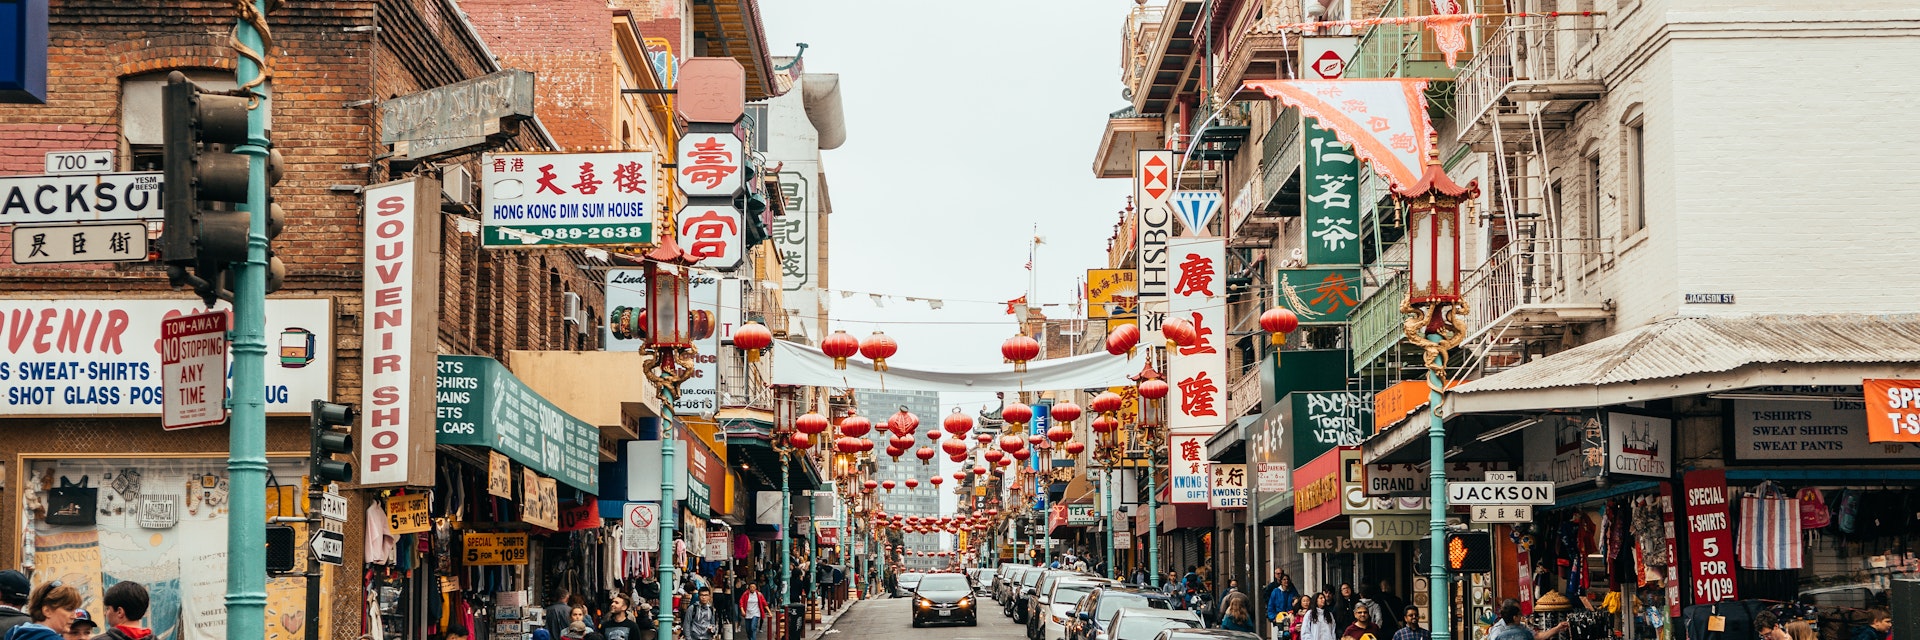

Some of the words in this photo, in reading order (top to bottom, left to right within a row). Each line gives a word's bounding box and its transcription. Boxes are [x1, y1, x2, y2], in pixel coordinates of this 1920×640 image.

[55, 155, 87, 170] 700
[493, 157, 524, 173] 香港
[536, 161, 647, 195] 天喜樓
[1307, 124, 1358, 252] 仁茗茶
[493, 204, 524, 219] HONG
[527, 204, 557, 219] KONG
[560, 203, 579, 218] DIM
[582, 203, 605, 218] SUM
[607, 202, 644, 217] HOUSE
[541, 226, 642, 240] 989-2638
[1143, 208, 1168, 289] HSBC
[372, 195, 404, 374] SOUVENIR
[1687, 294, 1721, 303] JACKSON
[1723, 294, 1733, 303] ST
[0, 307, 129, 355] VENIR
[166, 317, 220, 335] TOW-AWAY
[163, 337, 179, 362] NO
[181, 337, 222, 360] STOPPING
[19, 361, 150, 380] SWEAT-SHIRTS
[180, 364, 205, 384] ANY
[8, 386, 56, 405] SHOT
[64, 386, 120, 405] GLASS
[265, 385, 288, 404] UG
[179, 386, 206, 406] TIME
[1753, 411, 1812, 421] T-SHIRTS
[1888, 413, 1920, 434] T-S
[370, 386, 399, 472] SHOP
[443, 423, 475, 434] CAPS
[1753, 427, 1796, 436] SWEAT
[1800, 426, 1848, 435] SHIRTS
[1753, 441, 1797, 451] SWEAT
[1801, 441, 1843, 450] PANTS
[1258, 463, 1267, 472] NO
[1174, 476, 1202, 488] KWONG
[1226, 467, 1244, 486] 行
[1373, 477, 1414, 491] GRAND
[1490, 473, 1505, 481] 700
[1213, 488, 1241, 496] KWONG
[1453, 486, 1548, 500] JACKSON
[1689, 487, 1724, 507] SPECIAL
[322, 497, 345, 516] GRANT
[1221, 498, 1248, 506] GIFTS
[1069, 507, 1086, 516] TEA
[391, 515, 399, 529] 5
[400, 517, 408, 525] FOR
[1376, 520, 1426, 537] JADE
[1688, 512, 1727, 533] T-SHIRTS
[467, 537, 492, 547] SPECIAL
[496, 537, 524, 547] T-SHIRTS
[1300, 536, 1333, 549] Fine
[1335, 536, 1393, 553] Jewelry
[1703, 537, 1719, 557] 5
[467, 549, 478, 561] 5
[1668, 544, 1674, 563] 5
[1700, 561, 1728, 575] FOR
